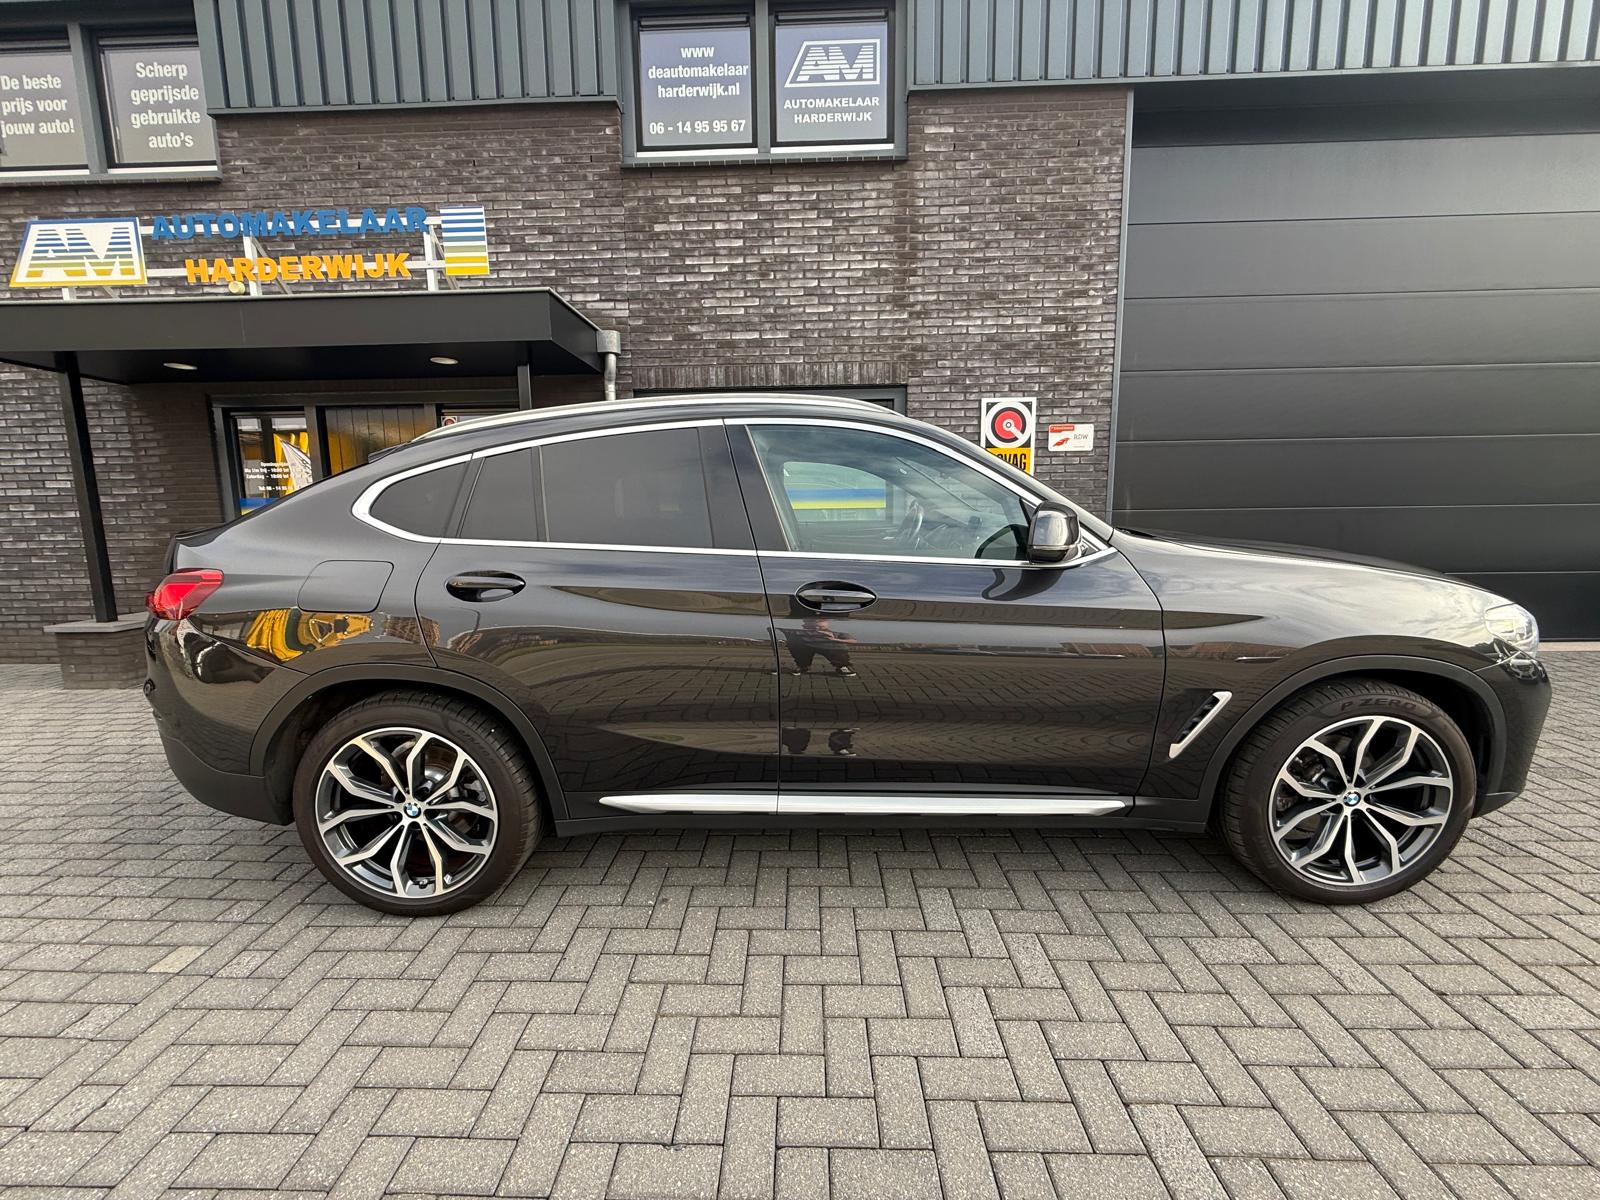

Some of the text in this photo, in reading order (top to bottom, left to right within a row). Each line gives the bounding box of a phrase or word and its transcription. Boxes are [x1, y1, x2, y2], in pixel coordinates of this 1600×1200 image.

[680, 47, 715, 58] www
[135, 62, 188, 80] Scherp
[648, 63, 749, 79] deautomakelaar
[0, 74, 62, 90] De beste
[131, 85, 199, 106] geprijsde
[657, 82, 740, 99] harderwijk.nl
[1, 99, 67, 116] prijs voor
[784, 96, 880, 109] AUTOMAKELAAR
[131, 109, 201, 129] gebruikte
[794, 112, 872, 124] HARDERWIJK
[0, 119, 75, 138] jouw auto!
[649, 122, 664, 135] 06
[676, 121, 691, 134] 14
[694, 121, 710, 133] 95
[713, 120, 728, 132] 95
[731, 119, 746, 132] 67
[149, 132, 194, 148] auto's
[151, 207, 429, 240] AUTOMAKELAAR
[185, 252, 412, 283] HARDERWIJK
[1341, 698, 1416, 711] P ZERO
